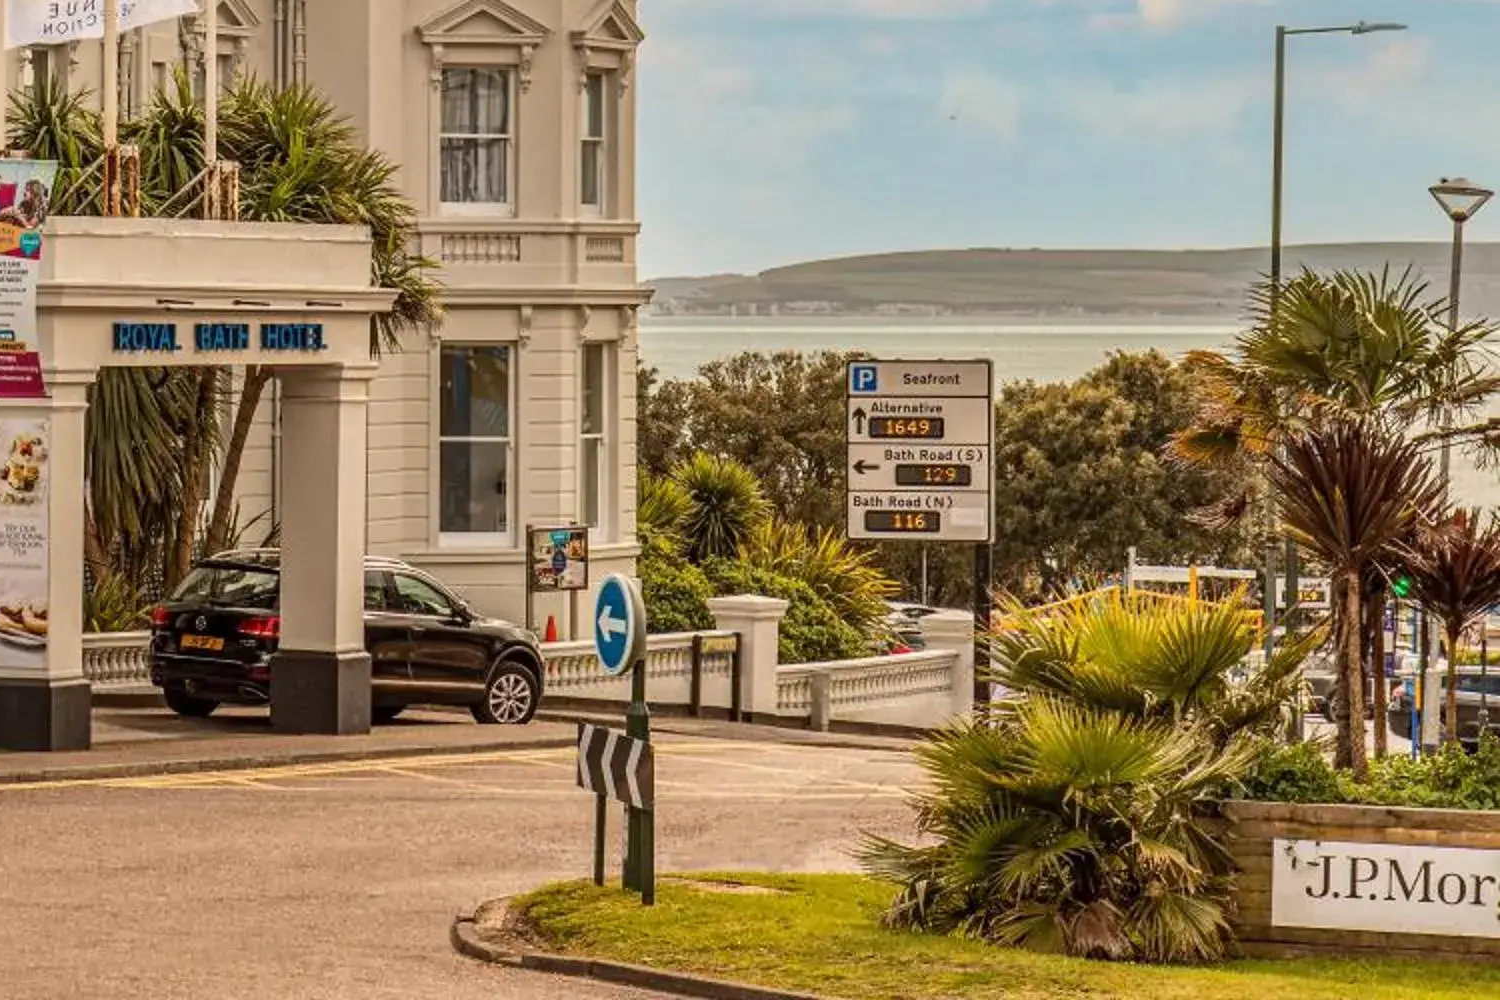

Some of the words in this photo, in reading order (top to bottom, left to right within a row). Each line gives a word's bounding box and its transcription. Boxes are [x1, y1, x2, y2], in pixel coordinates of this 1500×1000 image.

[113, 323, 183, 350] ROYAL
[194, 323, 249, 350] BATH
[260, 323, 329, 350] HOTEL
[858, 369, 873, 389] P
[903, 373, 961, 385] Seafront
[871, 402, 943, 413] Alternative
[886, 420, 930, 435] 1649
[884, 449, 914, 460] Bath
[920, 449, 952, 460] Road
[957, 449, 983, 462] (S)
[925, 468, 957, 481] 129
[853, 496, 883, 507] Bath
[889, 496, 921, 507] Road
[926, 496, 953, 508] (N)
[894, 513, 926, 528] 116
[1305, 855, 1500, 912] J.P.Mor
